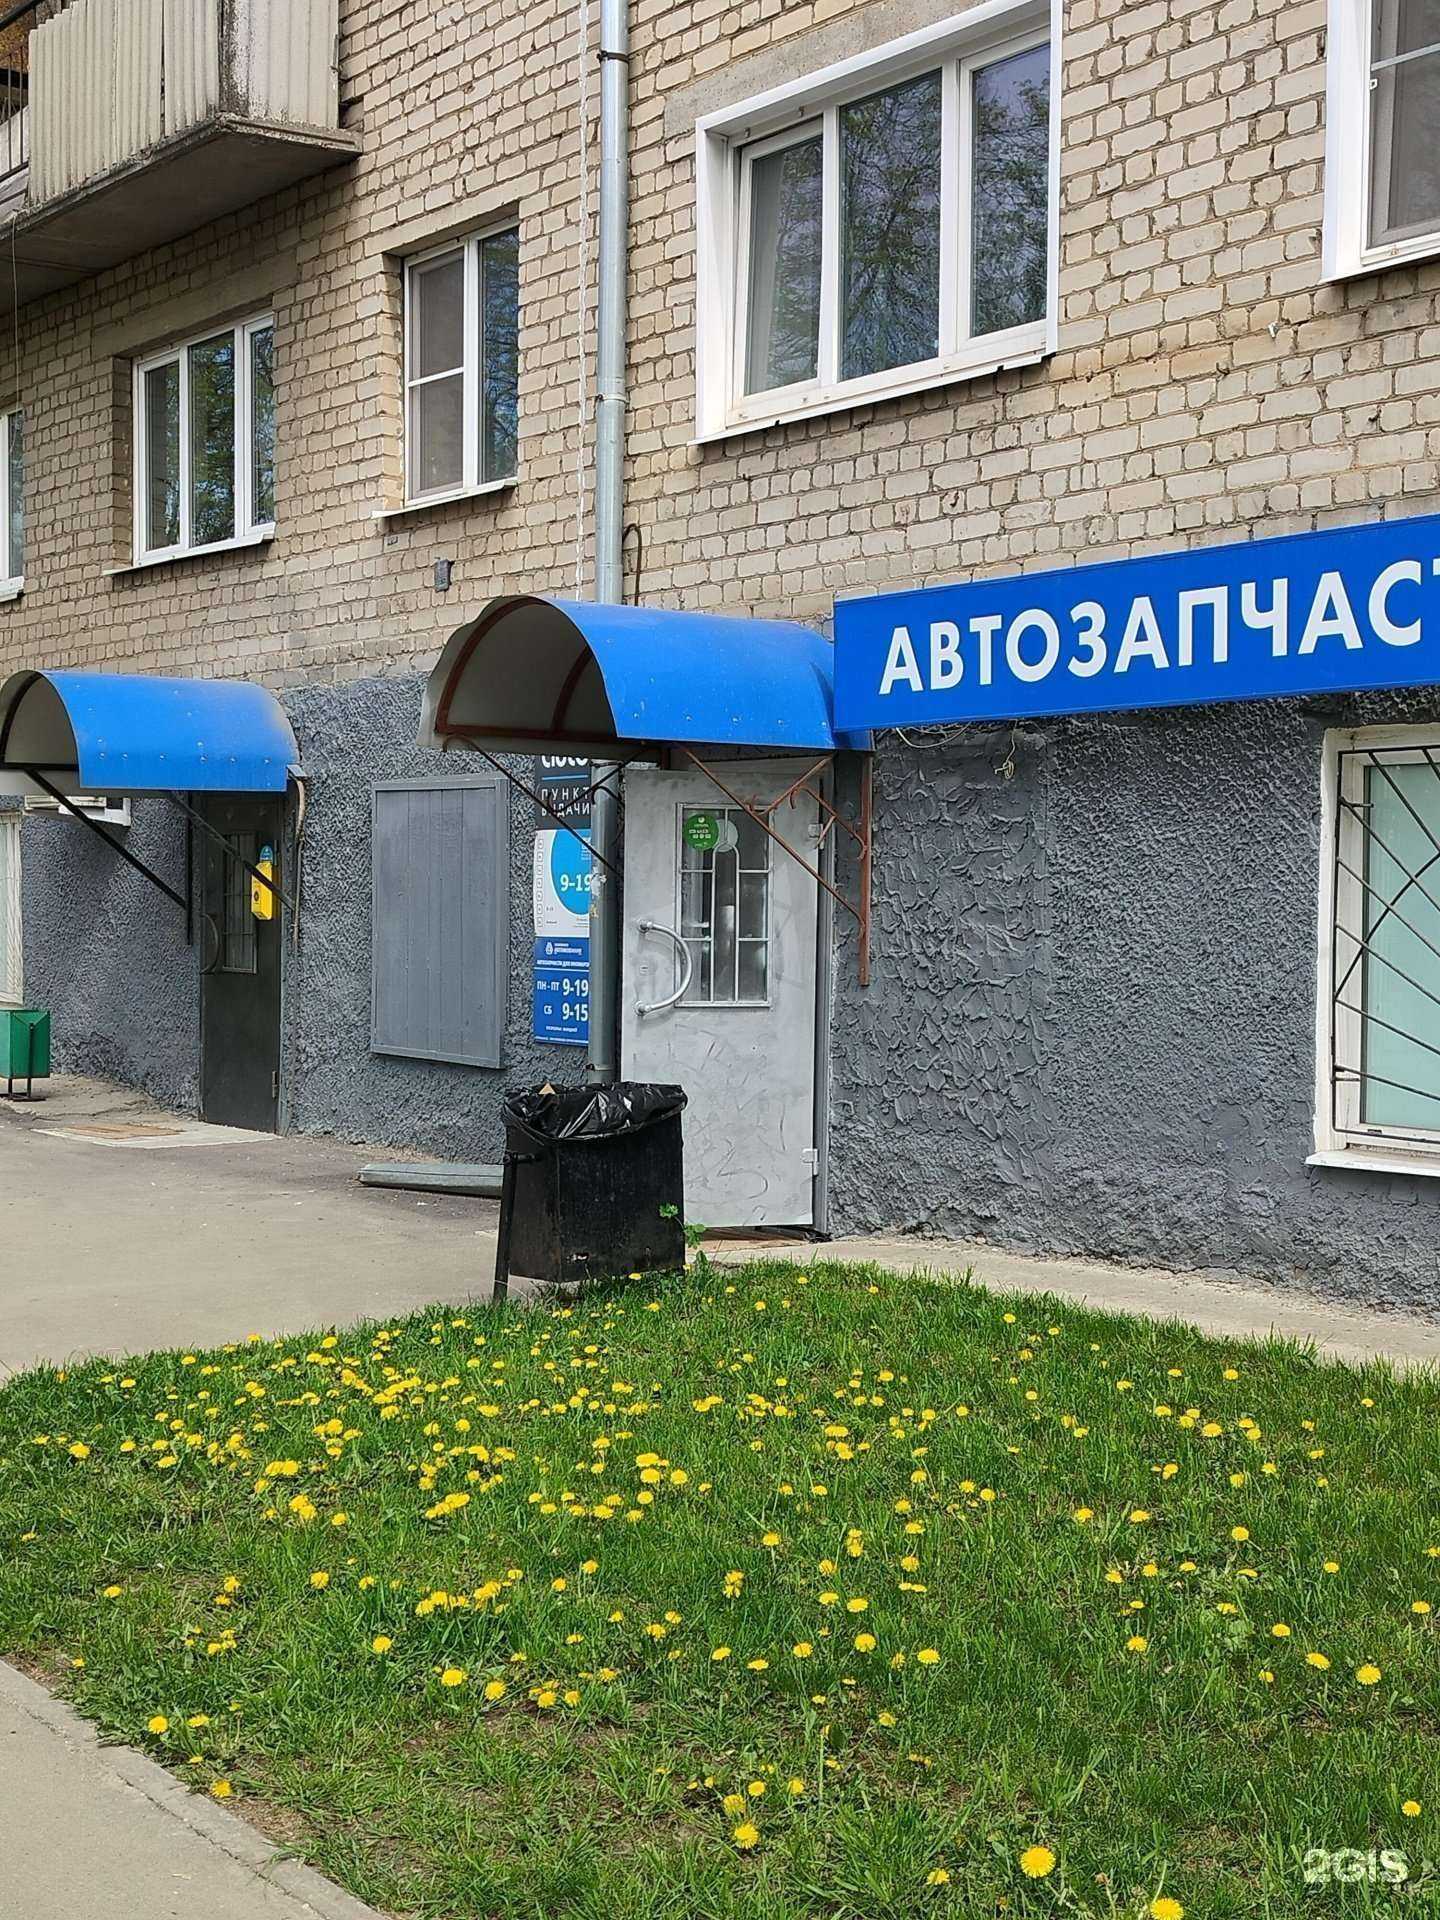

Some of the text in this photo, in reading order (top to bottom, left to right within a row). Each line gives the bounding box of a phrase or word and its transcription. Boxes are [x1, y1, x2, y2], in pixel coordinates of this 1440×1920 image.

[878, 557, 1440, 696] АВТОЗАПЧАС
[541, 786, 590, 801] ПУНКТ
[562, 978, 589, 997] 9-19
[543, 1002, 589, 1022] СБ 9-15
